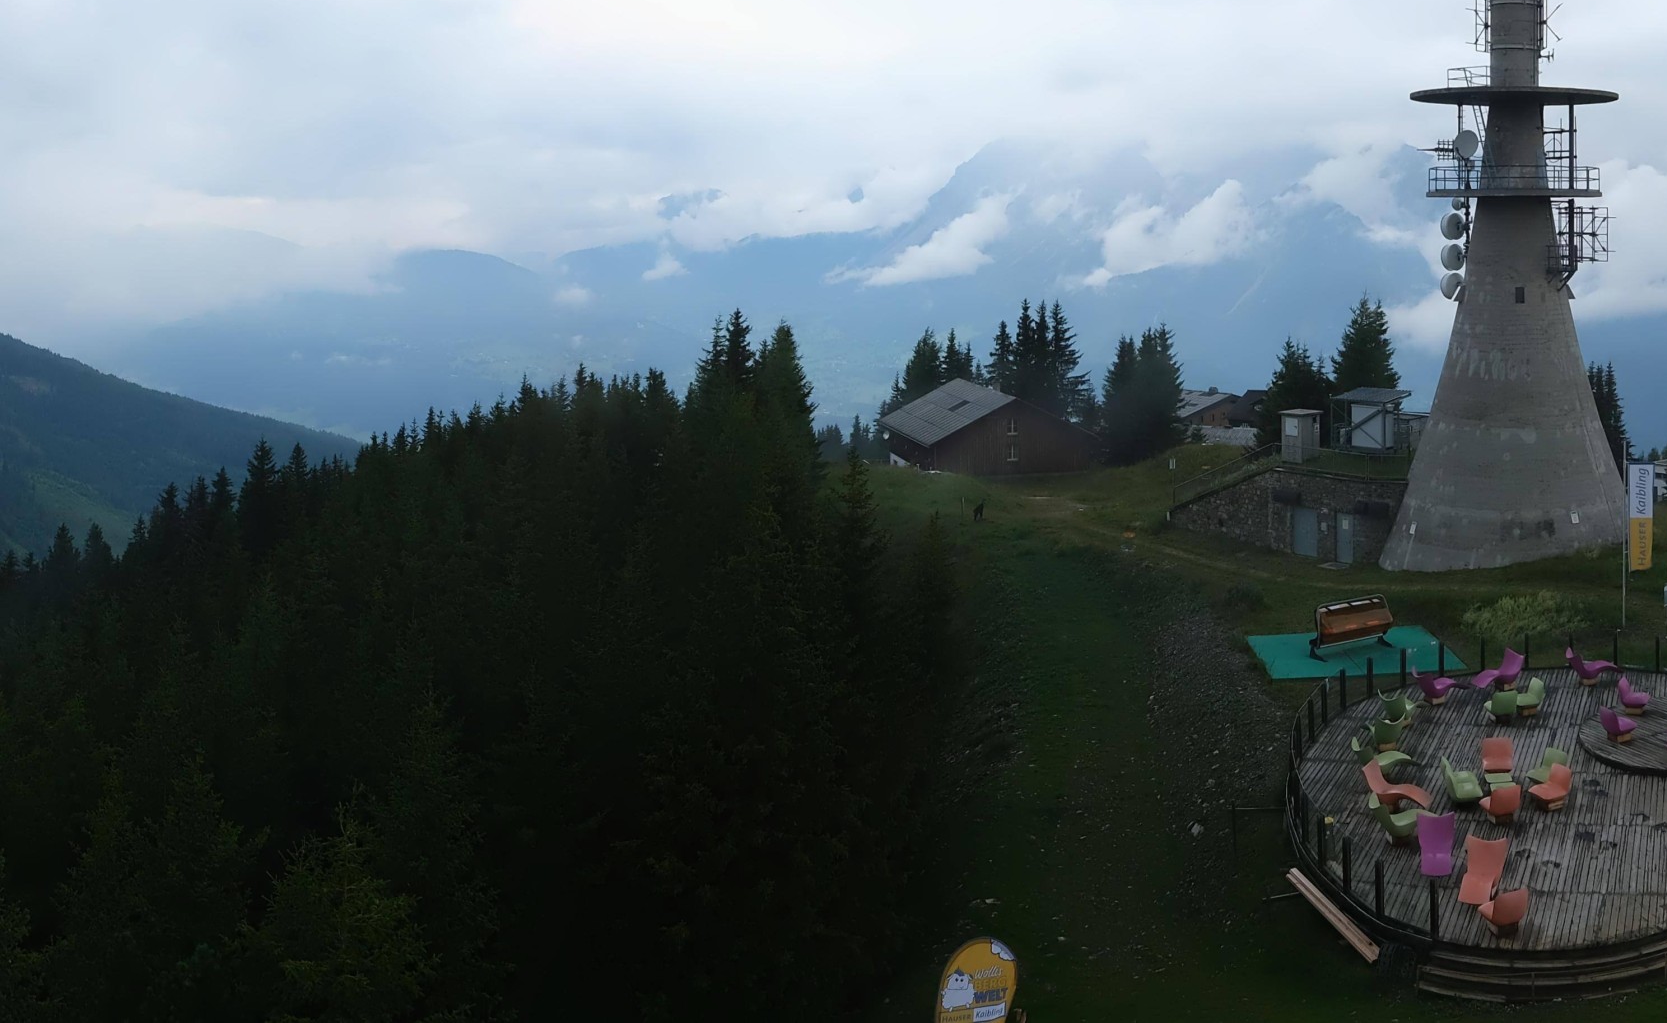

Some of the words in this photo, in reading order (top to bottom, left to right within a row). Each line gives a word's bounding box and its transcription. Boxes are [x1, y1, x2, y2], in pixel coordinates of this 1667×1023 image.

[1636, 468, 1650, 515] Kaibling
[1638, 522, 1647, 566] HAUSER
[975, 1008, 1004, 1019] Kaibling
